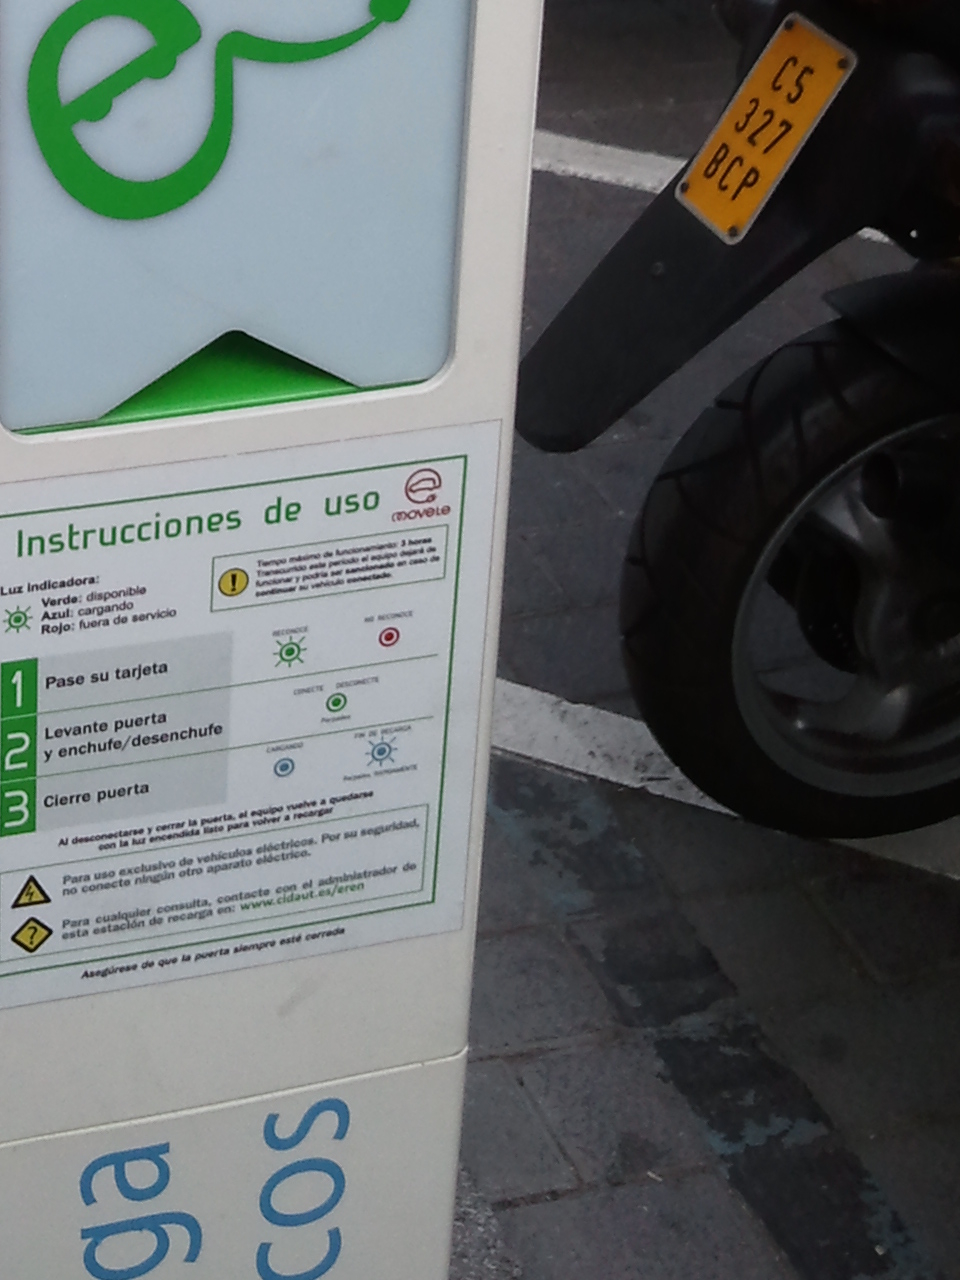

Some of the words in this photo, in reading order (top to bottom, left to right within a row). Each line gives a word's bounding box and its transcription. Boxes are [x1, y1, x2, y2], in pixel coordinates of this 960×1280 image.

[734, 98, 793, 154] 327
[703, 142, 761, 201] BCP
[17, 510, 241, 557] Instrucciones
[264, 496, 301, 525] de
[325, 491, 380, 516] uso
[401, 539, 406, 547] 3
[408, 537, 432, 546] horas
[0, 586, 23, 596] Luz
[41, 595, 82, 608] Verde:
[86, 585, 147, 602] disponible
[41, 608, 73, 621] Azul:
[77, 601, 134, 617] cargando
[41, 622, 74, 635] Rojo:
[79, 618, 110, 630] fuera
[113, 615, 128, 625] de
[132, 609, 177, 623] servicio
[11, 670, 22, 707] 1
[45, 675, 85, 690] Pase
[90, 671, 109, 683] su
[115, 663, 168, 680] tarjeta
[44, 750, 53, 763] y
[58, 723, 223, 758] enchufe/desenchufe
[45, 721, 108, 740] Levante
[114, 713, 167, 733] puerta
[4, 732, 30, 771] 2
[4, 790, 29, 828] 3
[43, 792, 91, 808] Cierre
[97, 784, 149, 803] puerta
[58, 838, 69, 846] Al
[71, 828, 144, 845] desconectarse
[147, 827, 152, 835] y
[155, 821, 185, 832] cerrar
[188, 819, 198, 827] la
[200, 814, 236, 827] puerta,
[238, 810, 248, 819] el
[250, 806, 284, 817] equipo
[286, 800, 317, 811] vuelve
[329, 791, 374, 805] quedarse
[98, 842, 117, 851] con
[119, 840, 129, 848] la
[132, 837, 146, 846] luz
[149, 829, 200, 843] encendida
[227, 821, 250, 832] para
[252, 816, 281, 826] volver
[293, 807, 333, 820] recargar
[62, 874, 91, 885] Para
[94, 870, 116, 881] uso
[118, 860, 176, 876] exclusivo
[179, 857, 194, 867] de
[197, 848, 253, 864] vehículos
[321, 833, 341, 843] Por
[343, 830, 358, 839] su
[360, 818, 420, 837] seguridad,
[62, 887, 78, 896] no
[81, 878, 131, 893] conecte
[134, 870, 175, 885] ningún
[178, 867, 203, 878] otro
[206, 858, 253, 874] aparato
[61, 929, 89, 940] esta
[149, 916, 164, 926] de
[167, 905, 213, 923] recarga
[217, 905, 235, 915] en:
[240, 882, 365, 911] www.cidaut.es/eren
[62, 918, 90, 931] Para
[95, 908, 151, 926] cualquier
[156, 898, 212, 914] consulta,
[216, 888, 270, 904] contacte
[275, 884, 297, 896] con
[302, 879, 313, 892] el
[318, 866, 398, 887] administrador
[402, 862, 417, 872] de
[141, 960, 155, 970] de
[158, 957, 178, 968] que
[181, 954, 191, 962] la
[194, 948, 230, 962] puerta
[233, 940, 276, 954] siempre
[255, 1097, 351, 1280] cos
[79, 1142, 203, 1280] ga
